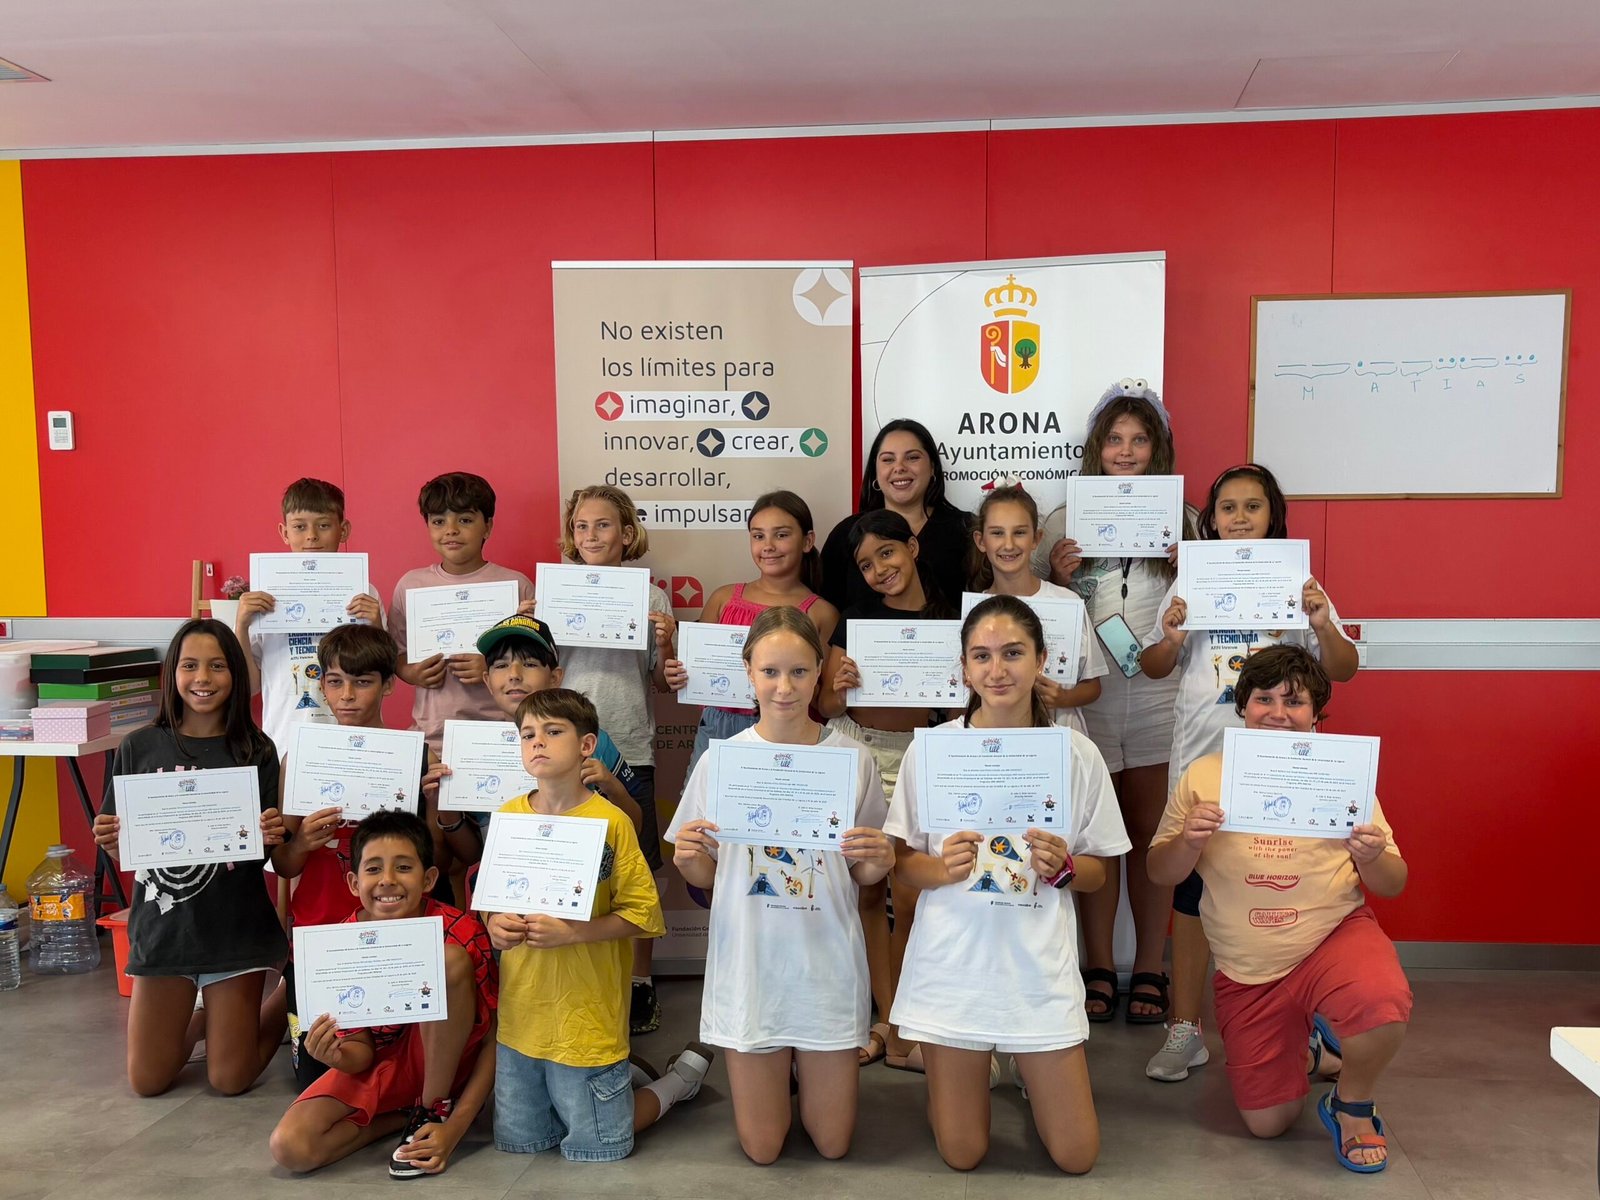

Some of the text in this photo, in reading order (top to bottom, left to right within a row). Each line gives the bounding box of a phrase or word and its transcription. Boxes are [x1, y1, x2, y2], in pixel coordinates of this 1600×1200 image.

[601, 321, 723, 340] No existen
[602, 357, 775, 391] los límites para
[629, 395, 736, 419] imaginar,
[957, 411, 1061, 434] ARONA
[604, 432, 795, 454] innovar, crear,
[937, 440, 1084, 466] Ayuntamiento
[604, 467, 732, 489] desarrollar,
[943, 468, 1009, 481] ROMOCIÓN
[288, 637, 312, 646] CIENCIA
[655, 725, 698, 735] CENTR
[656, 739, 695, 749] DE AR
